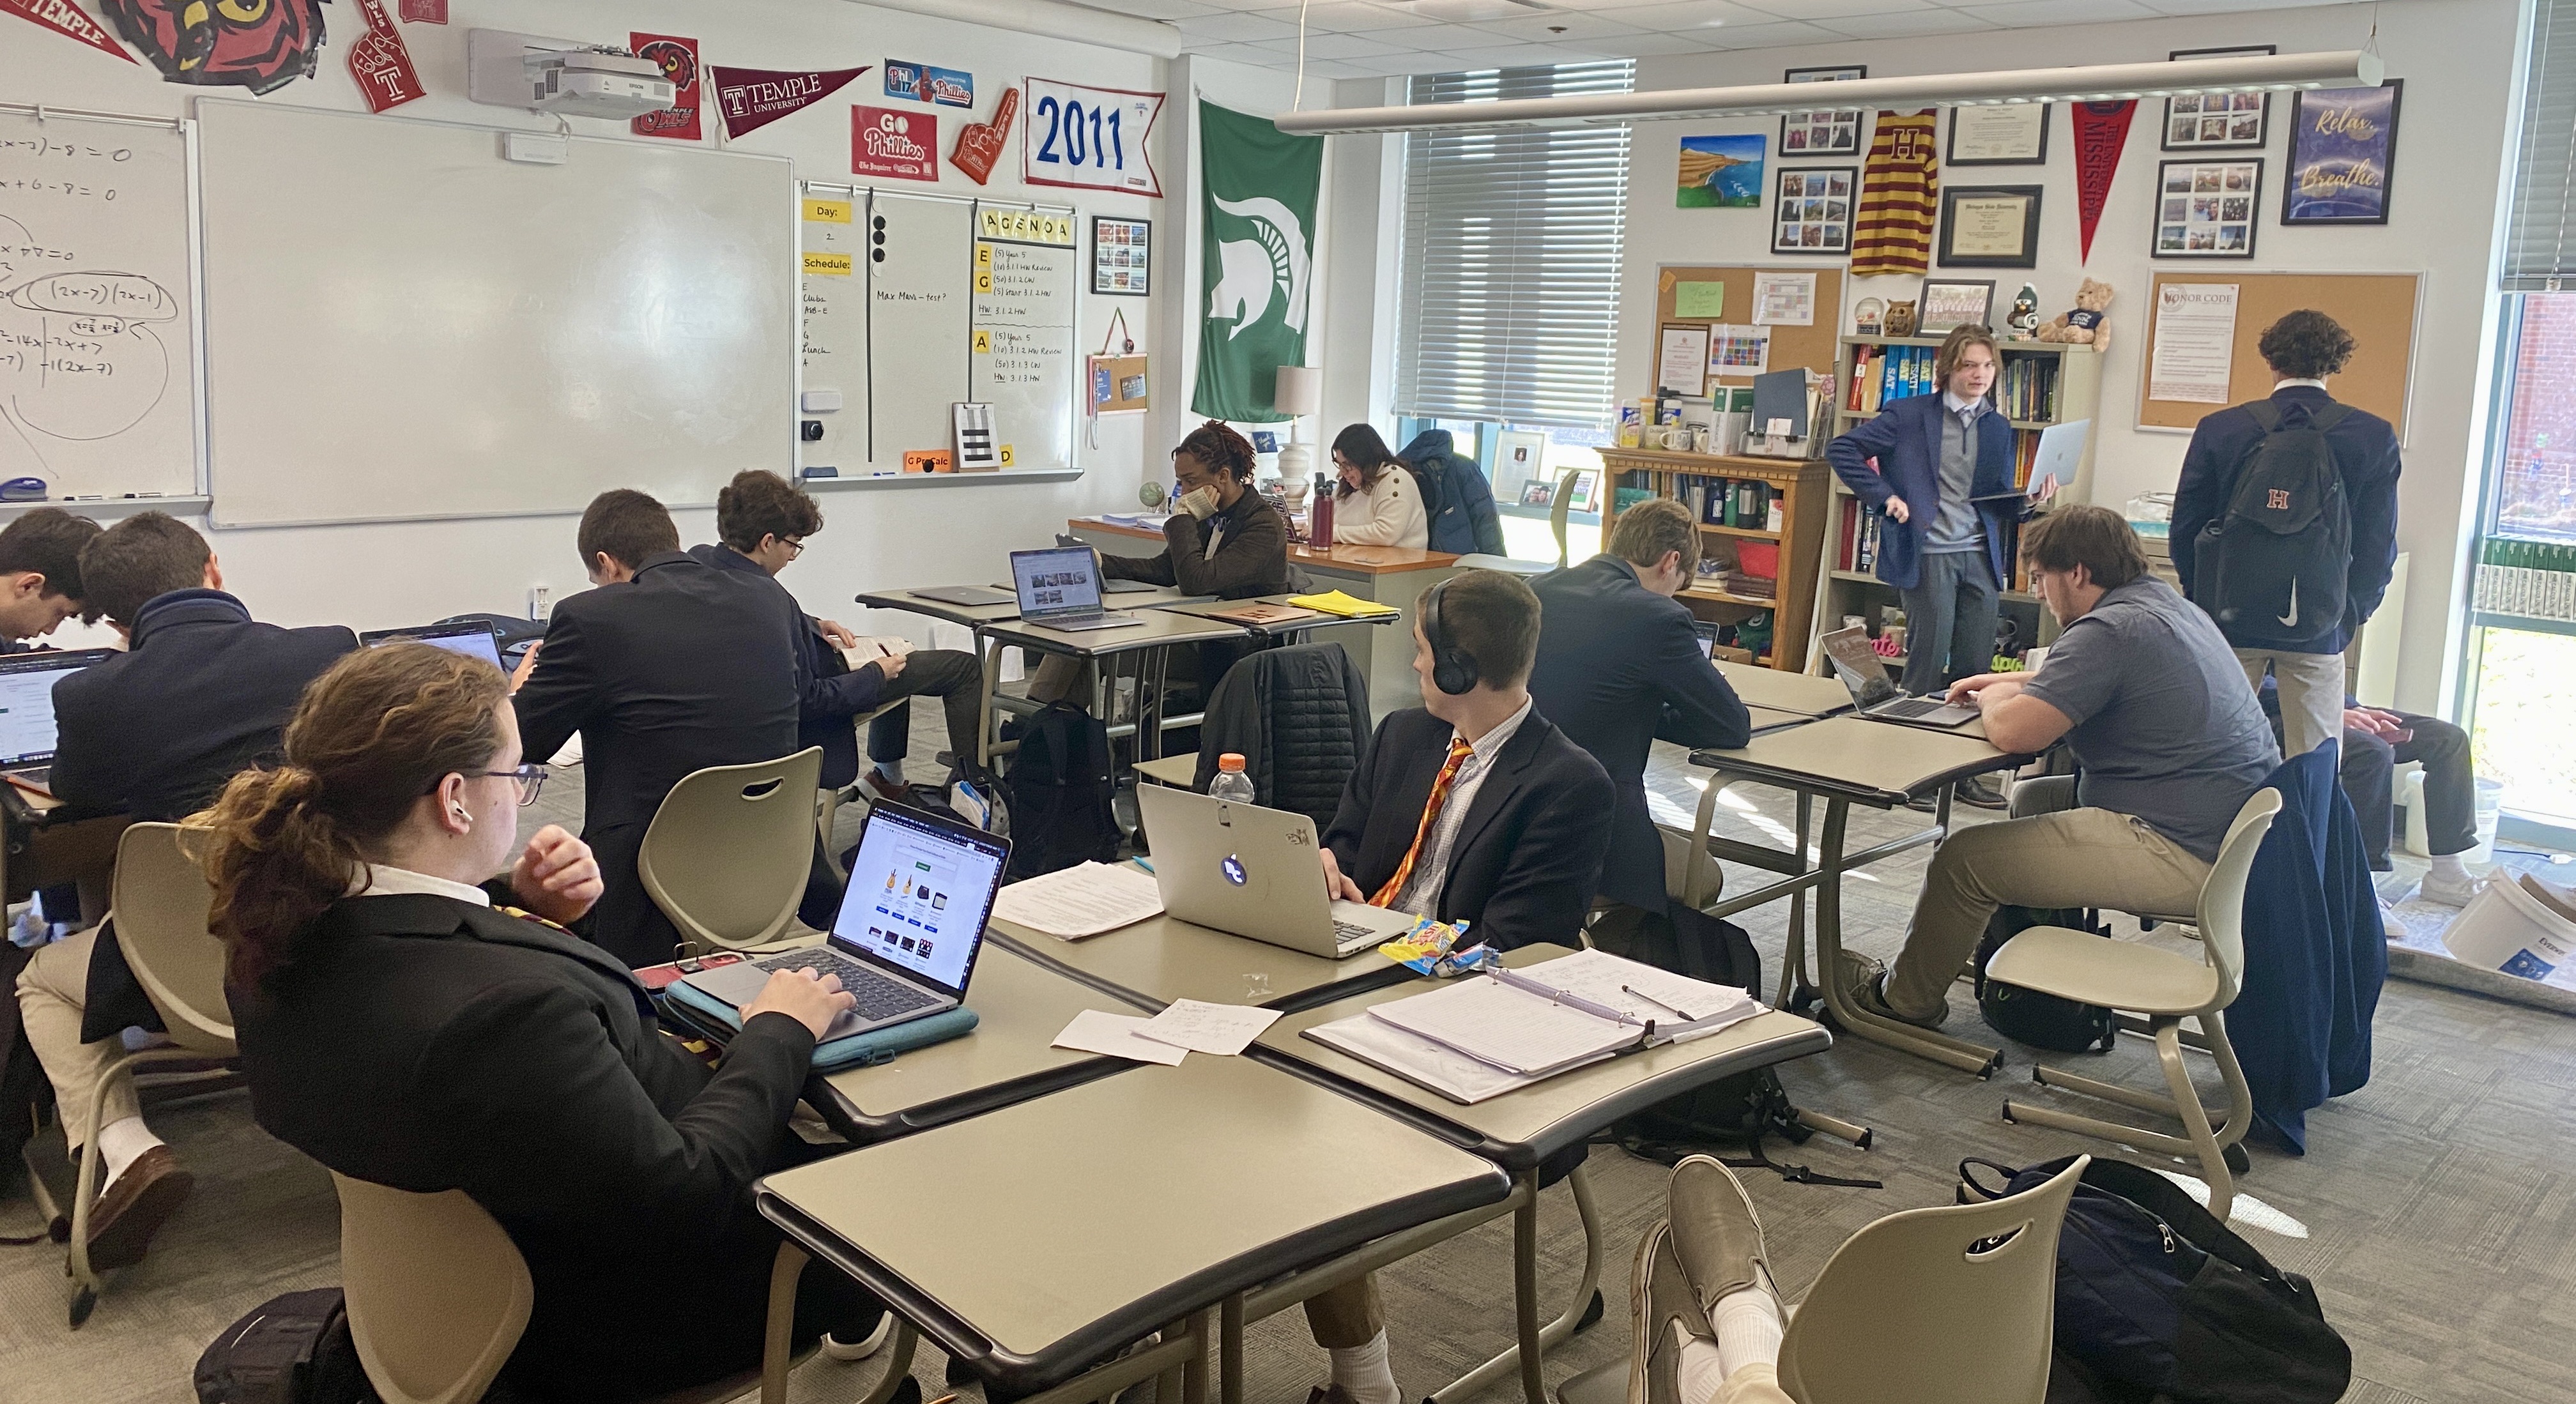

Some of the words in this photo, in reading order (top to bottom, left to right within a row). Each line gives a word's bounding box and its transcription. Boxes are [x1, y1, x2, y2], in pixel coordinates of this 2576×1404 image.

[30, 0, 105, 46] TEMPLE
[746, 73, 822, 103] TEMPLE
[936, 79, 970, 100] Phillies
[754, 97, 806, 113] UNIVERSITY
[2315, 106, 2374, 136] Relax.
[1037, 95, 1123, 171] 2011
[864, 127, 924, 160] Phillies
[1891, 128, 1919, 160] H
[859, 161, 870, 169] The
[870, 162, 892, 171] Inquirer
[2084, 121, 2106, 220] MISSISSIPPI
[2300, 158, 2379, 190] Breathe.
[817, 206, 838, 217] Day:
[987, 215, 1067, 236] AGENDA
[804, 259, 850, 270] Schedule:
[980, 250, 988, 262] E
[979, 275, 988, 288] G
[877, 290, 894, 300] Max
[926, 293, 946, 302] test?
[2204, 294, 2232, 303] CODE
[803, 319, 809, 327] F
[803, 332, 809, 340] G
[976, 336, 986, 348] A
[802, 342, 831, 355] Lunch
[1886, 367, 1896, 390] SAT
[1899, 359, 1910, 381] SAT
[1909, 364, 1920, 389] SAT
[1920, 359, 1931, 381] SAT
[908, 457, 914, 465] G
[916, 457, 948, 466] PrCalc
[1001, 450, 1011, 462] D
[2267, 489, 2289, 509] H
